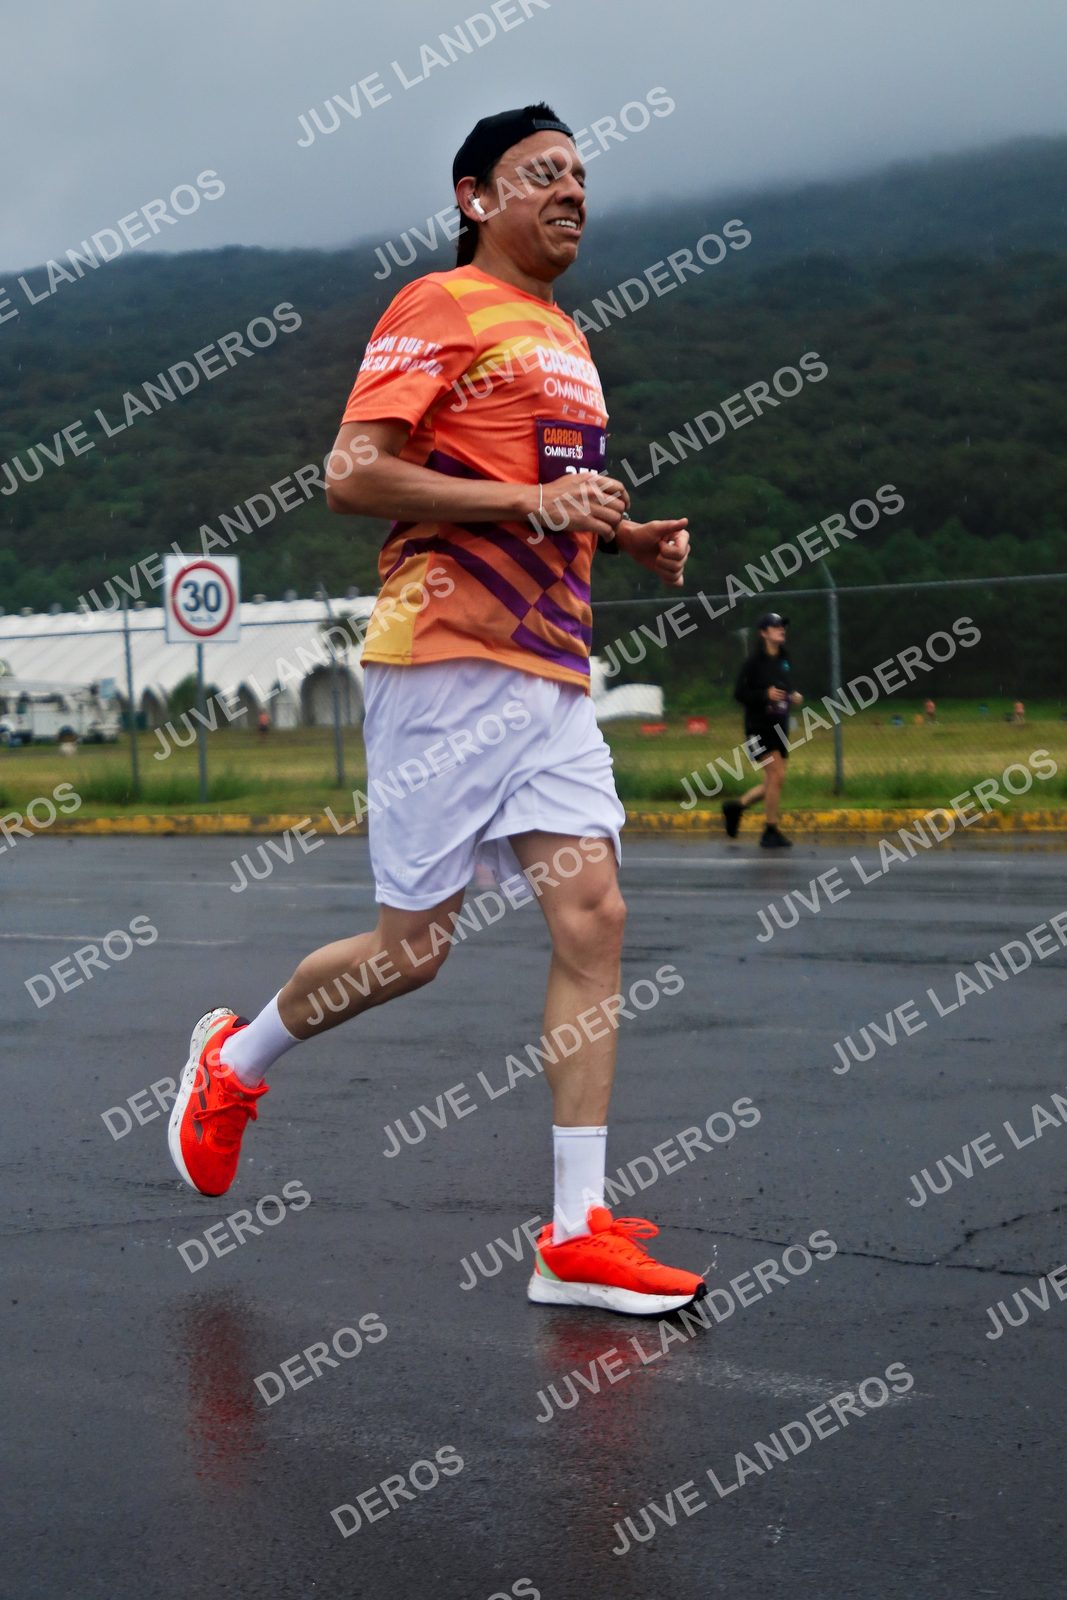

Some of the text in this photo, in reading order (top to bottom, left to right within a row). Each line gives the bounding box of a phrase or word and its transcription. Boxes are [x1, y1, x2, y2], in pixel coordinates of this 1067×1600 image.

[544, 428, 583, 447] CARRERA
[544, 445, 576, 458] OMNILIFE
[182, 580, 221, 612] 30
